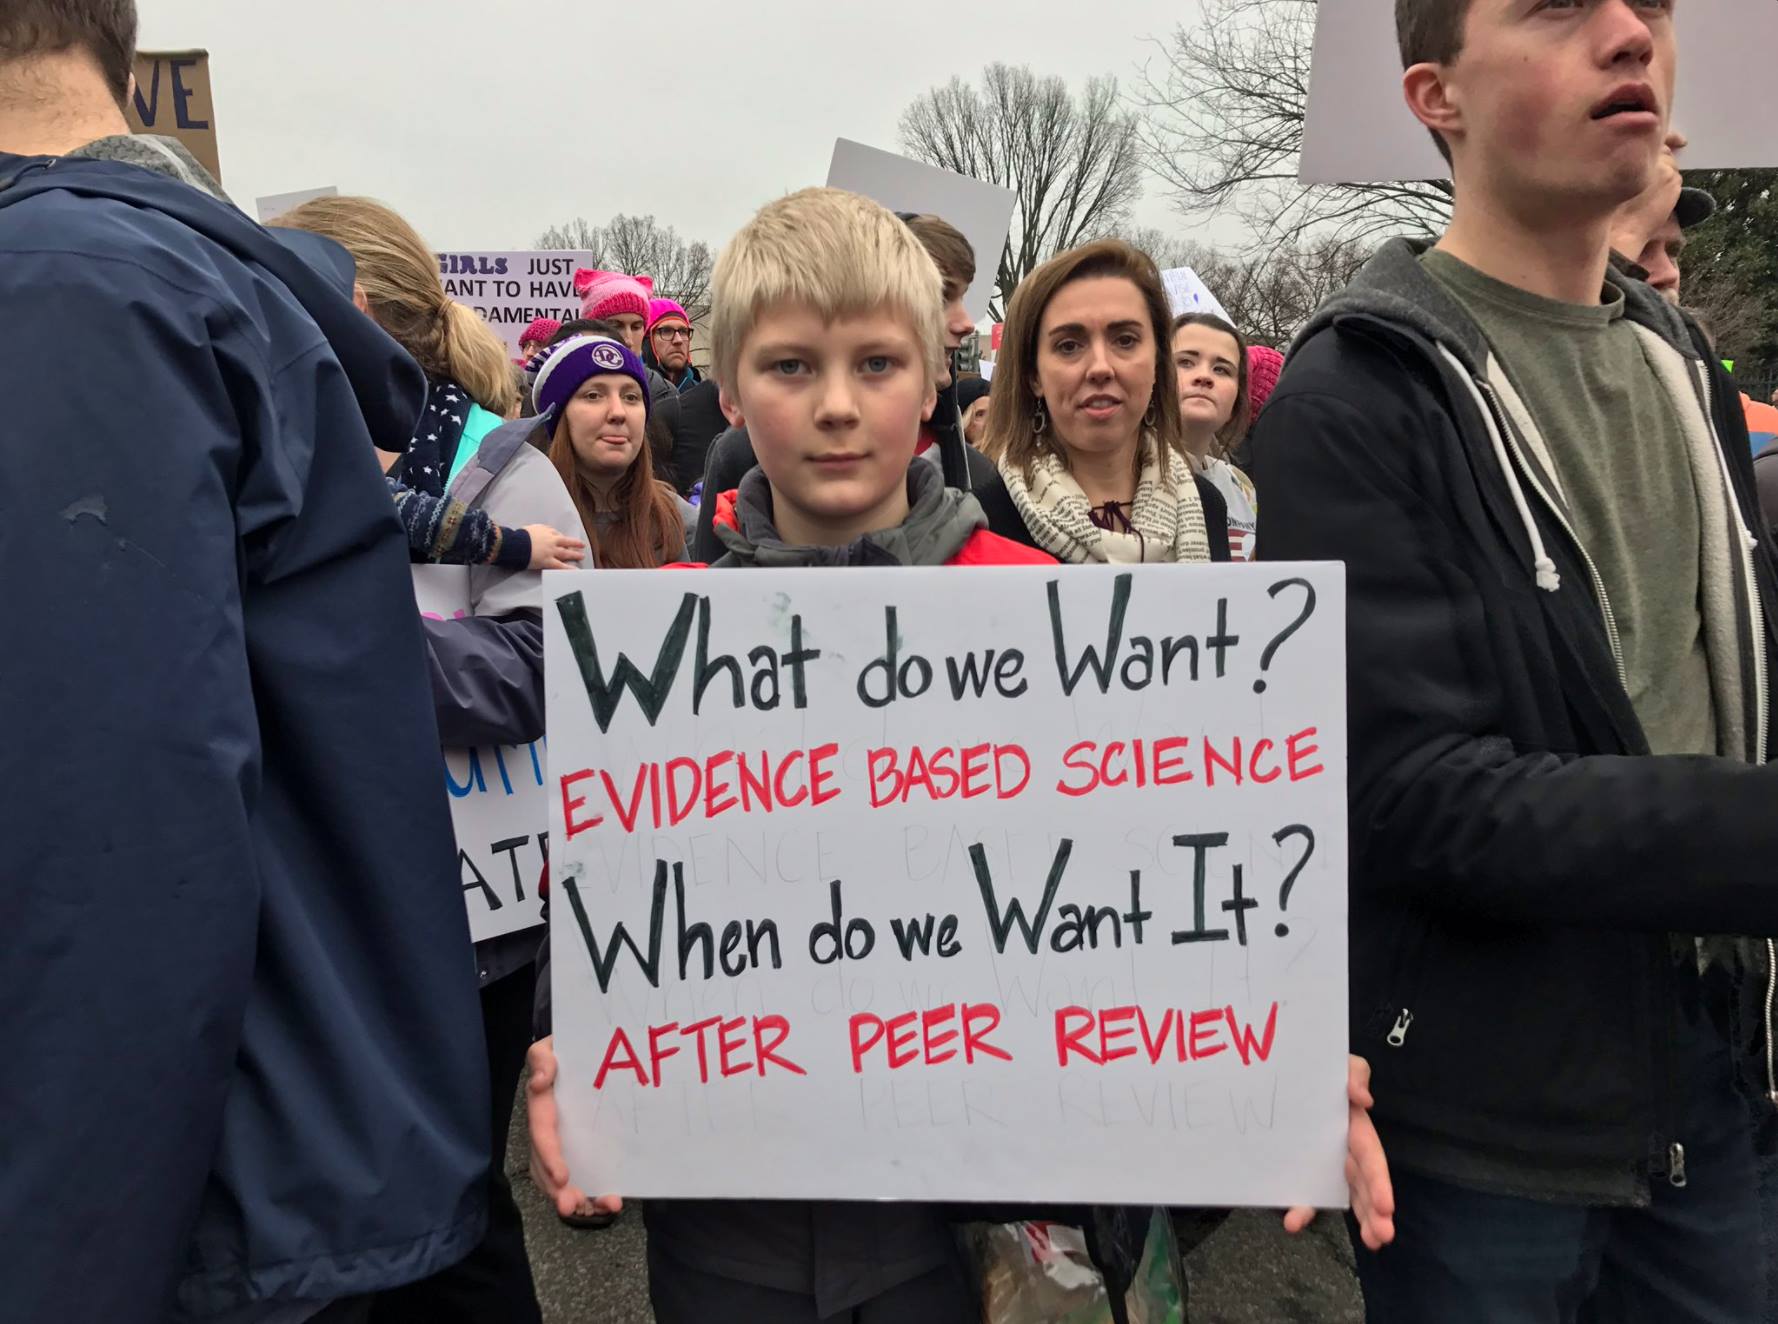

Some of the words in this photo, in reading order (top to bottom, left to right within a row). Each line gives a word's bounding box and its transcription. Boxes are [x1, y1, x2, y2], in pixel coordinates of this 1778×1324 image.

[440, 279, 487, 297] ANT
[493, 280, 521, 298] TO
[527, 258, 574, 275] JUST
[556, 591, 820, 734] What
[857, 606, 932, 707] do
[946, 649, 1027, 700] we
[1047, 574, 1315, 696] Want?
[560, 743, 841, 840] EVIDENCE
[867, 743, 1031, 809] BASED
[1056, 727, 1324, 797] SCIENCE
[562, 859, 781, 993] When
[809, 880, 875, 964] do
[890, 914, 962, 961] we
[969, 839, 1152, 954] Want
[1172, 825, 1314, 945] It?
[594, 1015, 806, 1089] AFTER
[849, 1004, 1013, 1073] PEER
[1055, 1003, 1278, 1068] REVIEW
